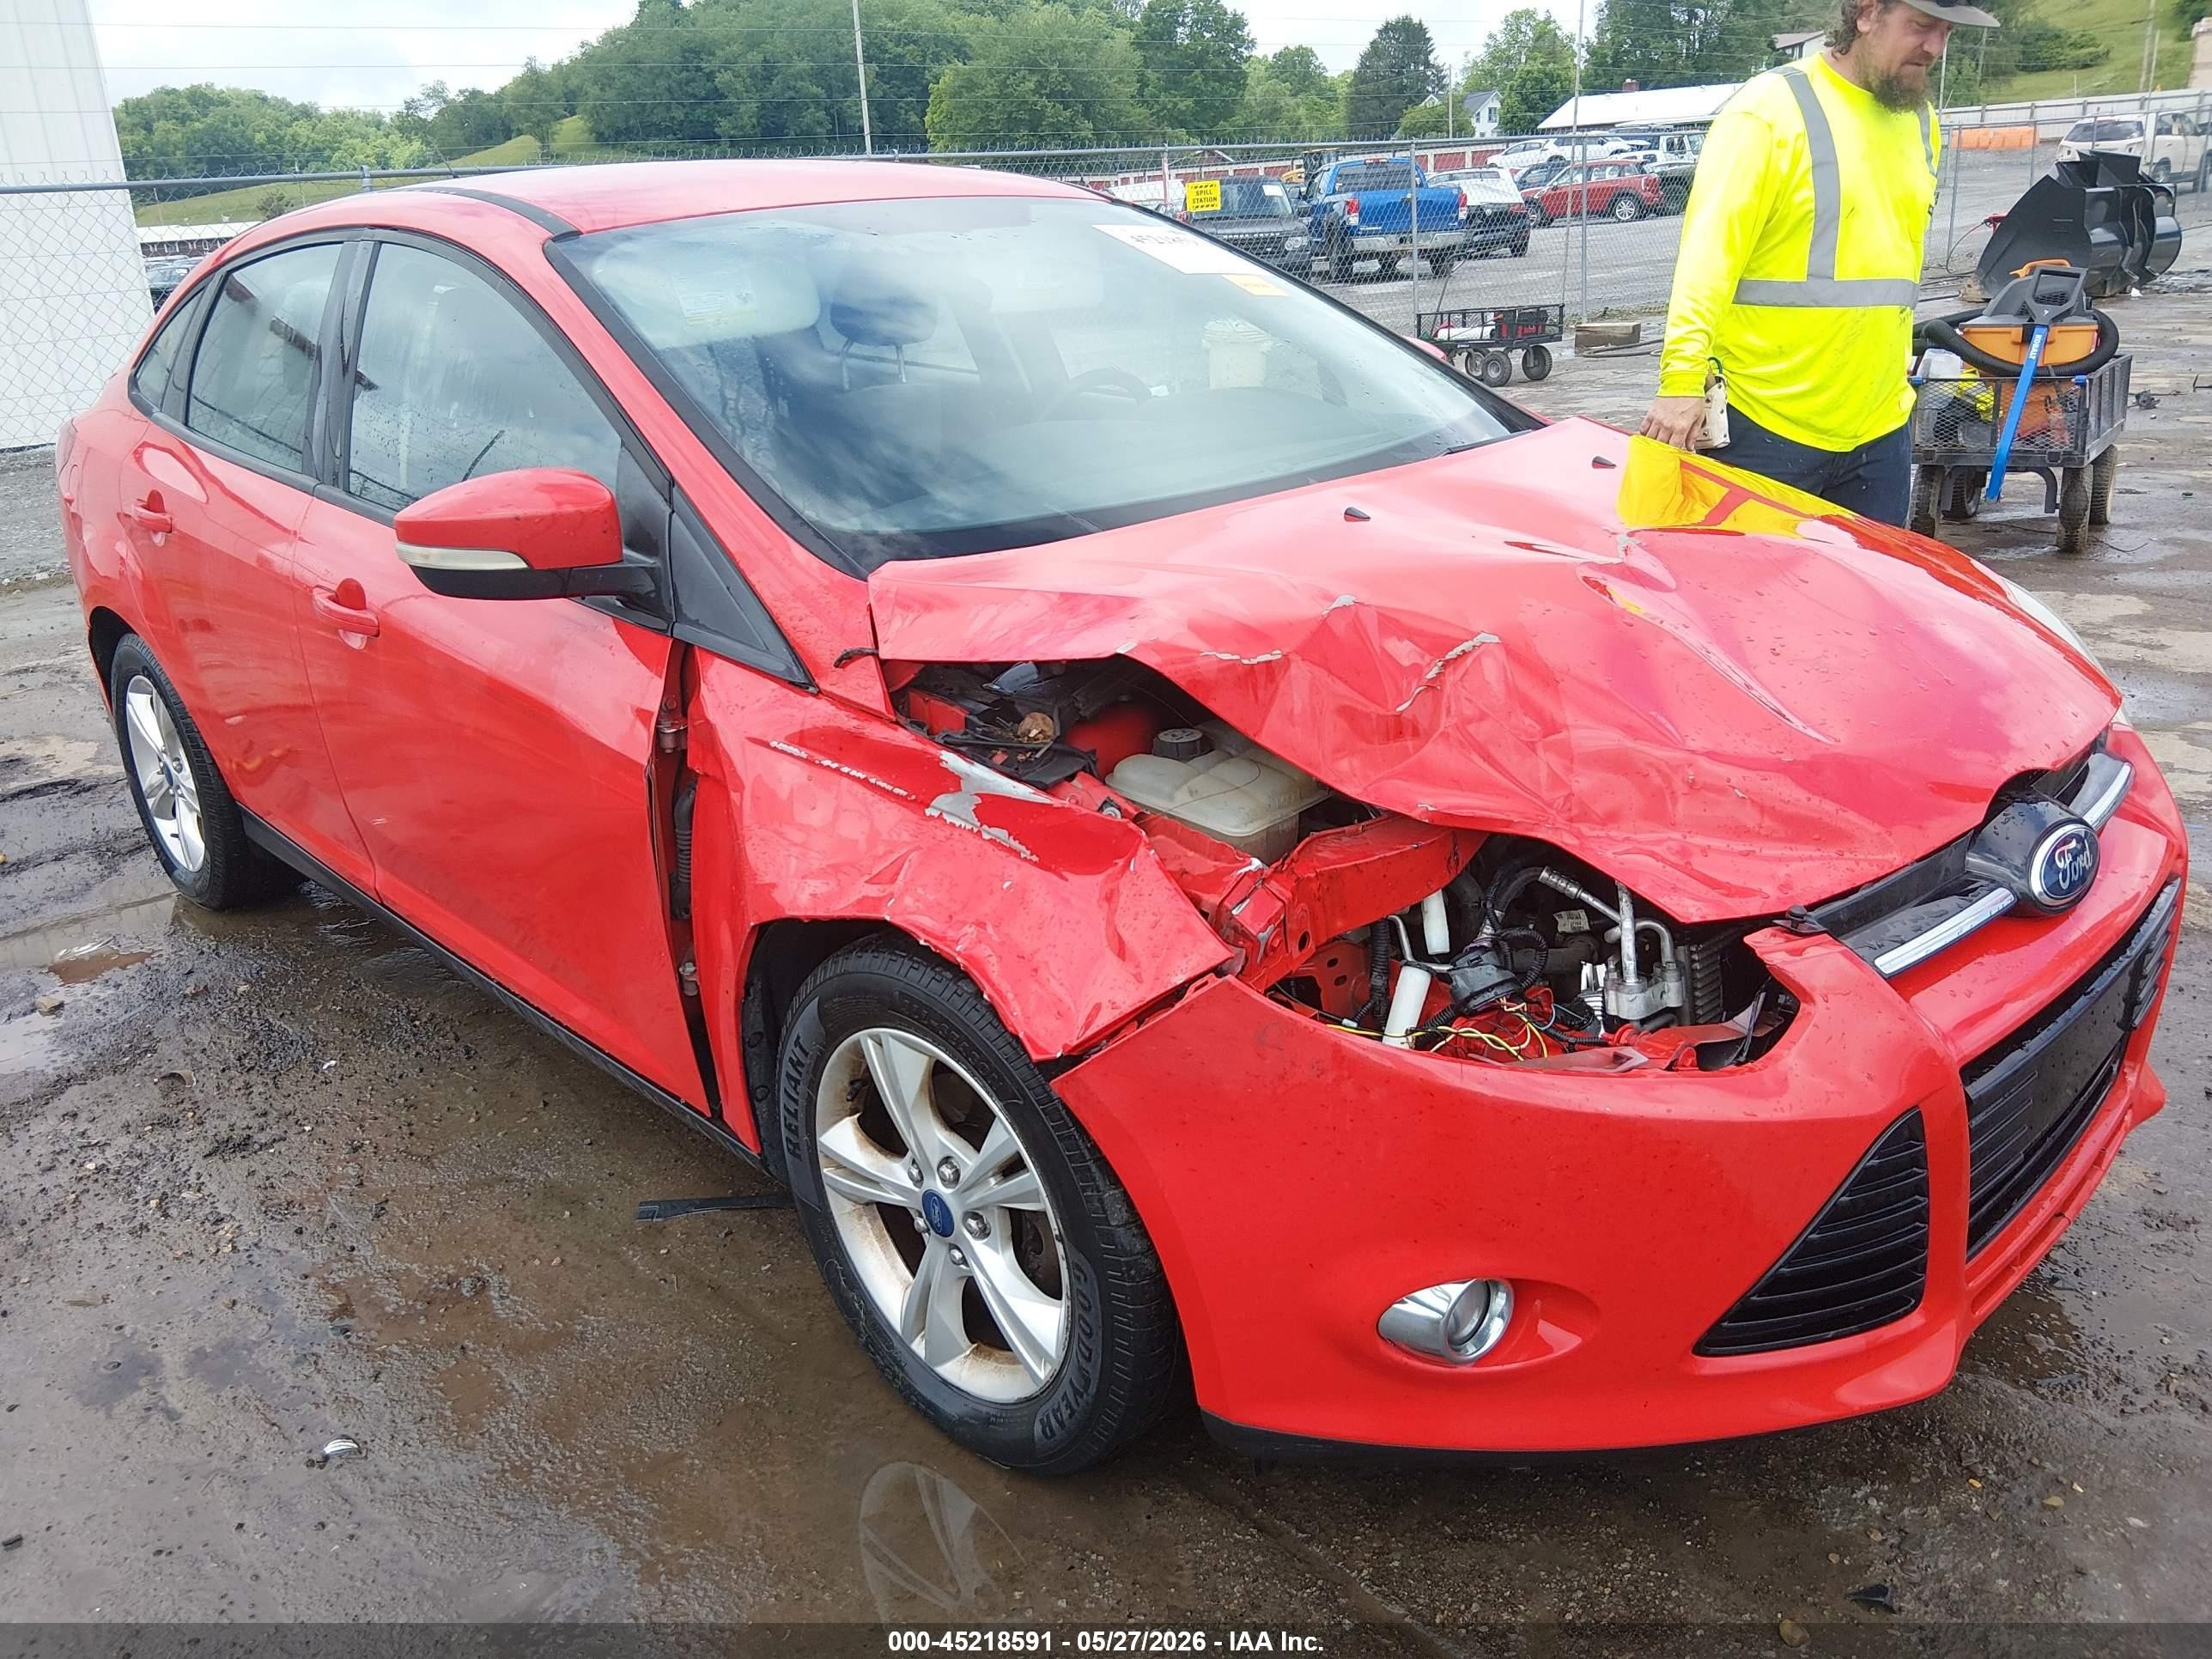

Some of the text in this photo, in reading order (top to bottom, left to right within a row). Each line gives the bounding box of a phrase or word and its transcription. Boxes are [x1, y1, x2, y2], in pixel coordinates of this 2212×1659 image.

[2028, 334, 2043, 360] KOBALT
[2054, 837, 2094, 890] Ford
[782, 1032, 812, 1160] RELIANT
[1038, 1259, 1093, 1441] GOODYEAR
